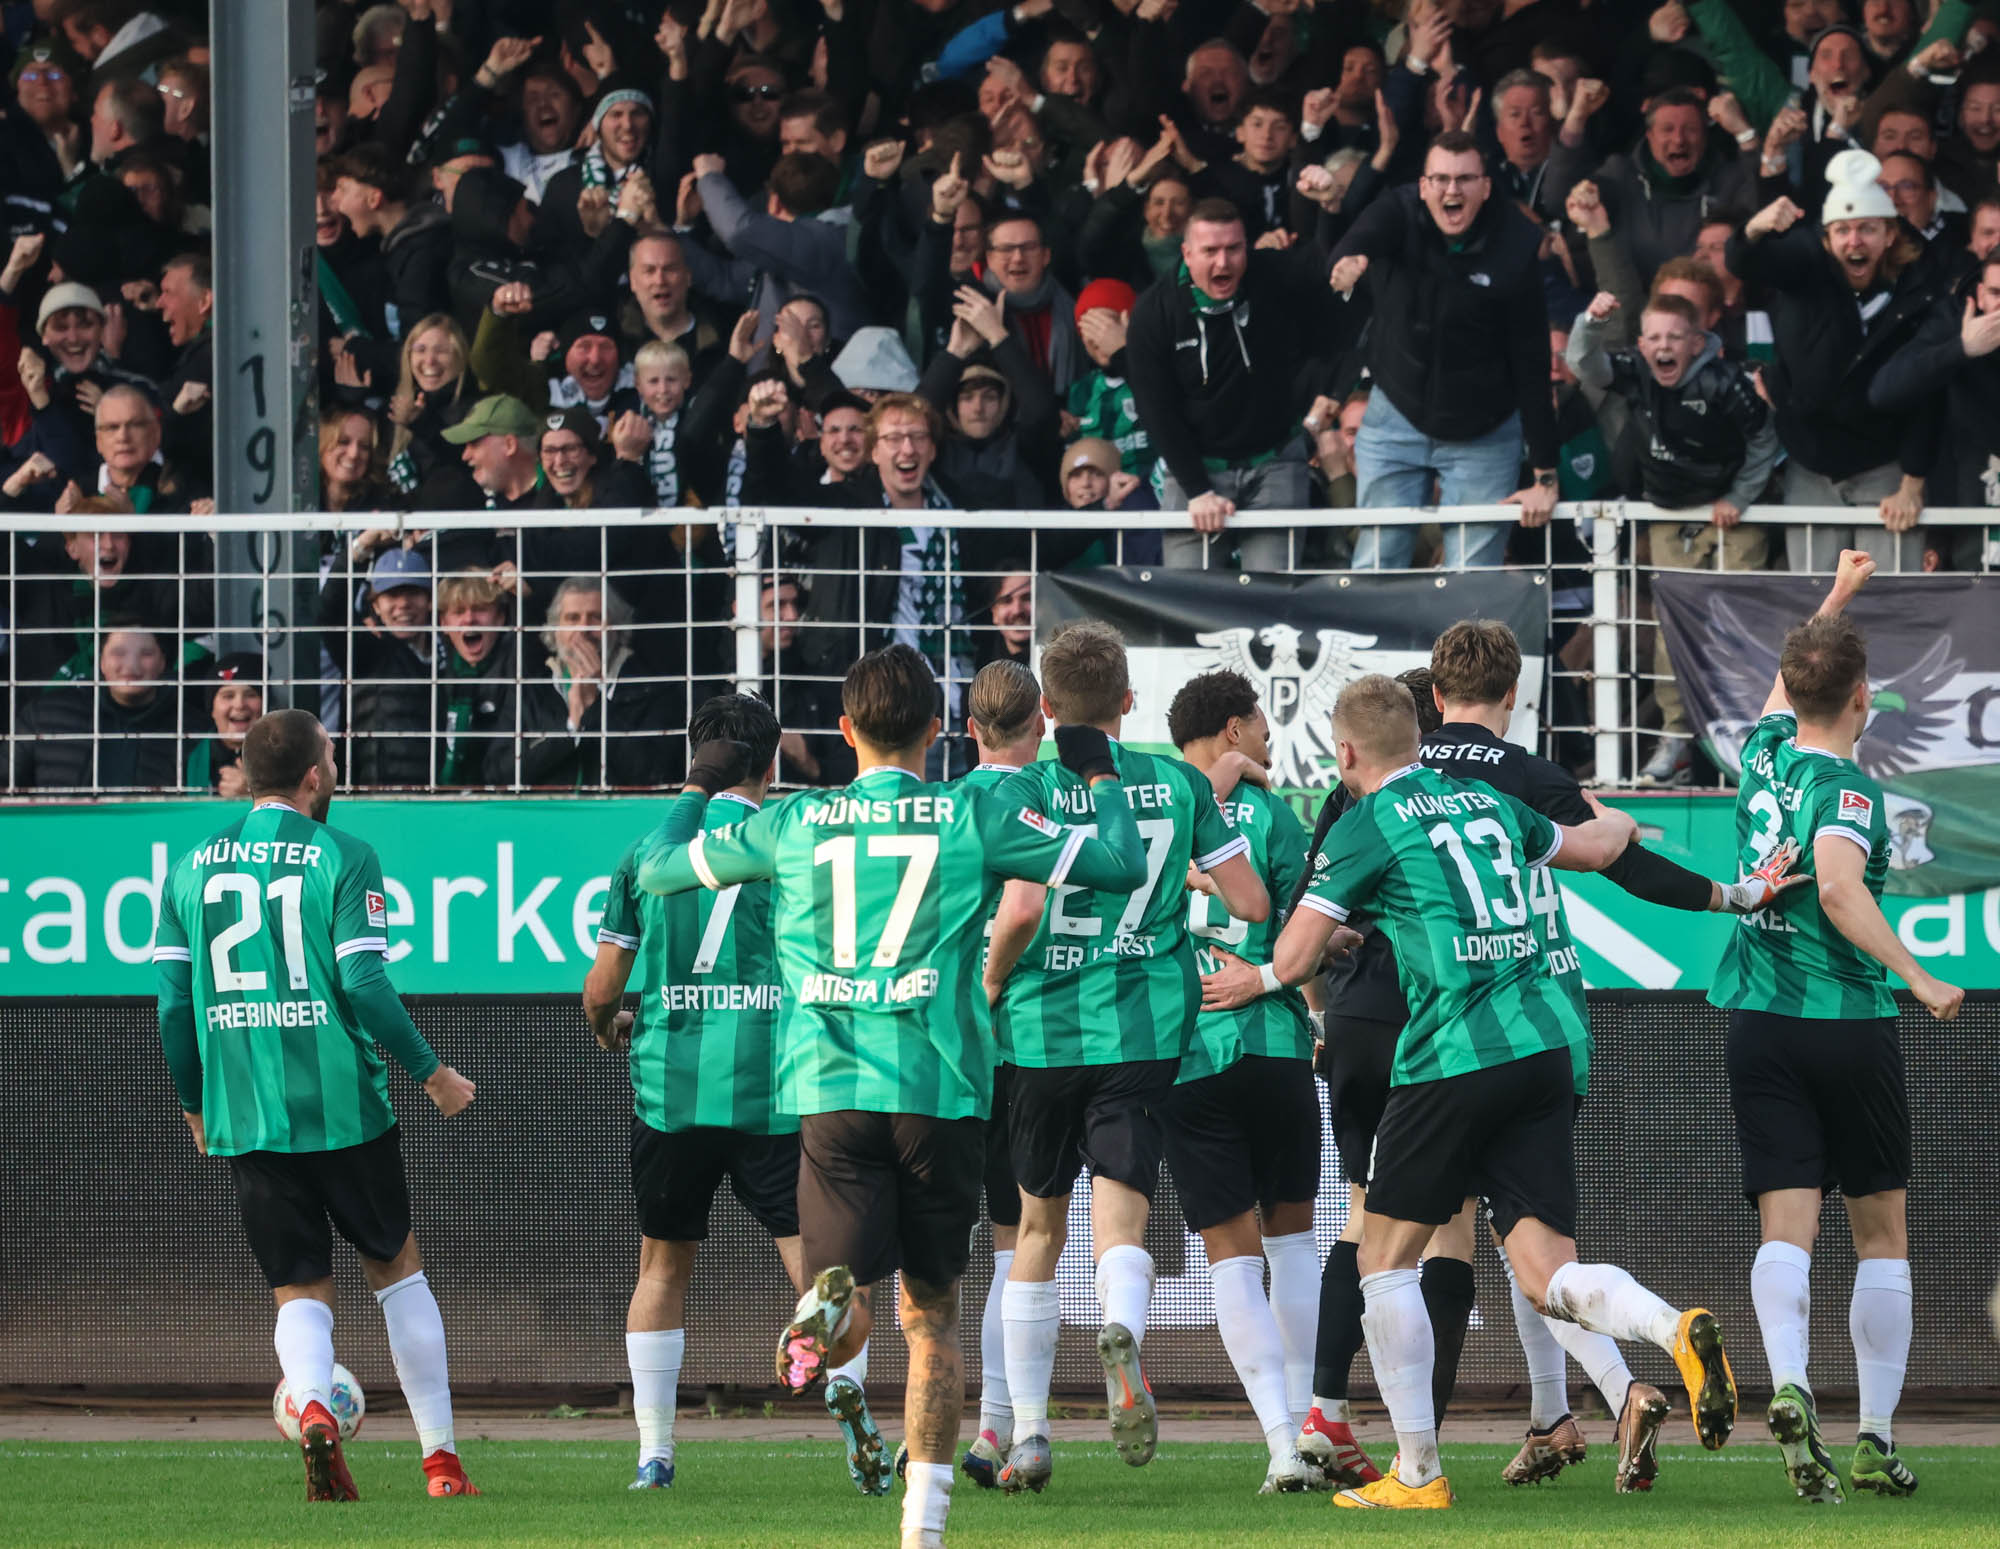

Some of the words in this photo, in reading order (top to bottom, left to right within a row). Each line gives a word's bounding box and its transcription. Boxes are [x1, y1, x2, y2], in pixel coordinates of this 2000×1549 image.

[1274, 678, 1300, 719] P
[1419, 743, 1506, 766] NSTER
[801, 796, 955, 827] MÜNSTER
[1052, 783, 1174, 815] MÜTER
[1393, 791, 1500, 823] MÜNSTER
[192, 838, 322, 870] MÜNSTER
[1428, 817, 1528, 929] 13
[813, 834, 940, 969] 17
[203, 872, 309, 993] 21
[661, 984, 783, 1011] SERTDEMIR
[799, 974, 879, 1004] BATISTA
[883, 968, 939, 1004] MEIER
